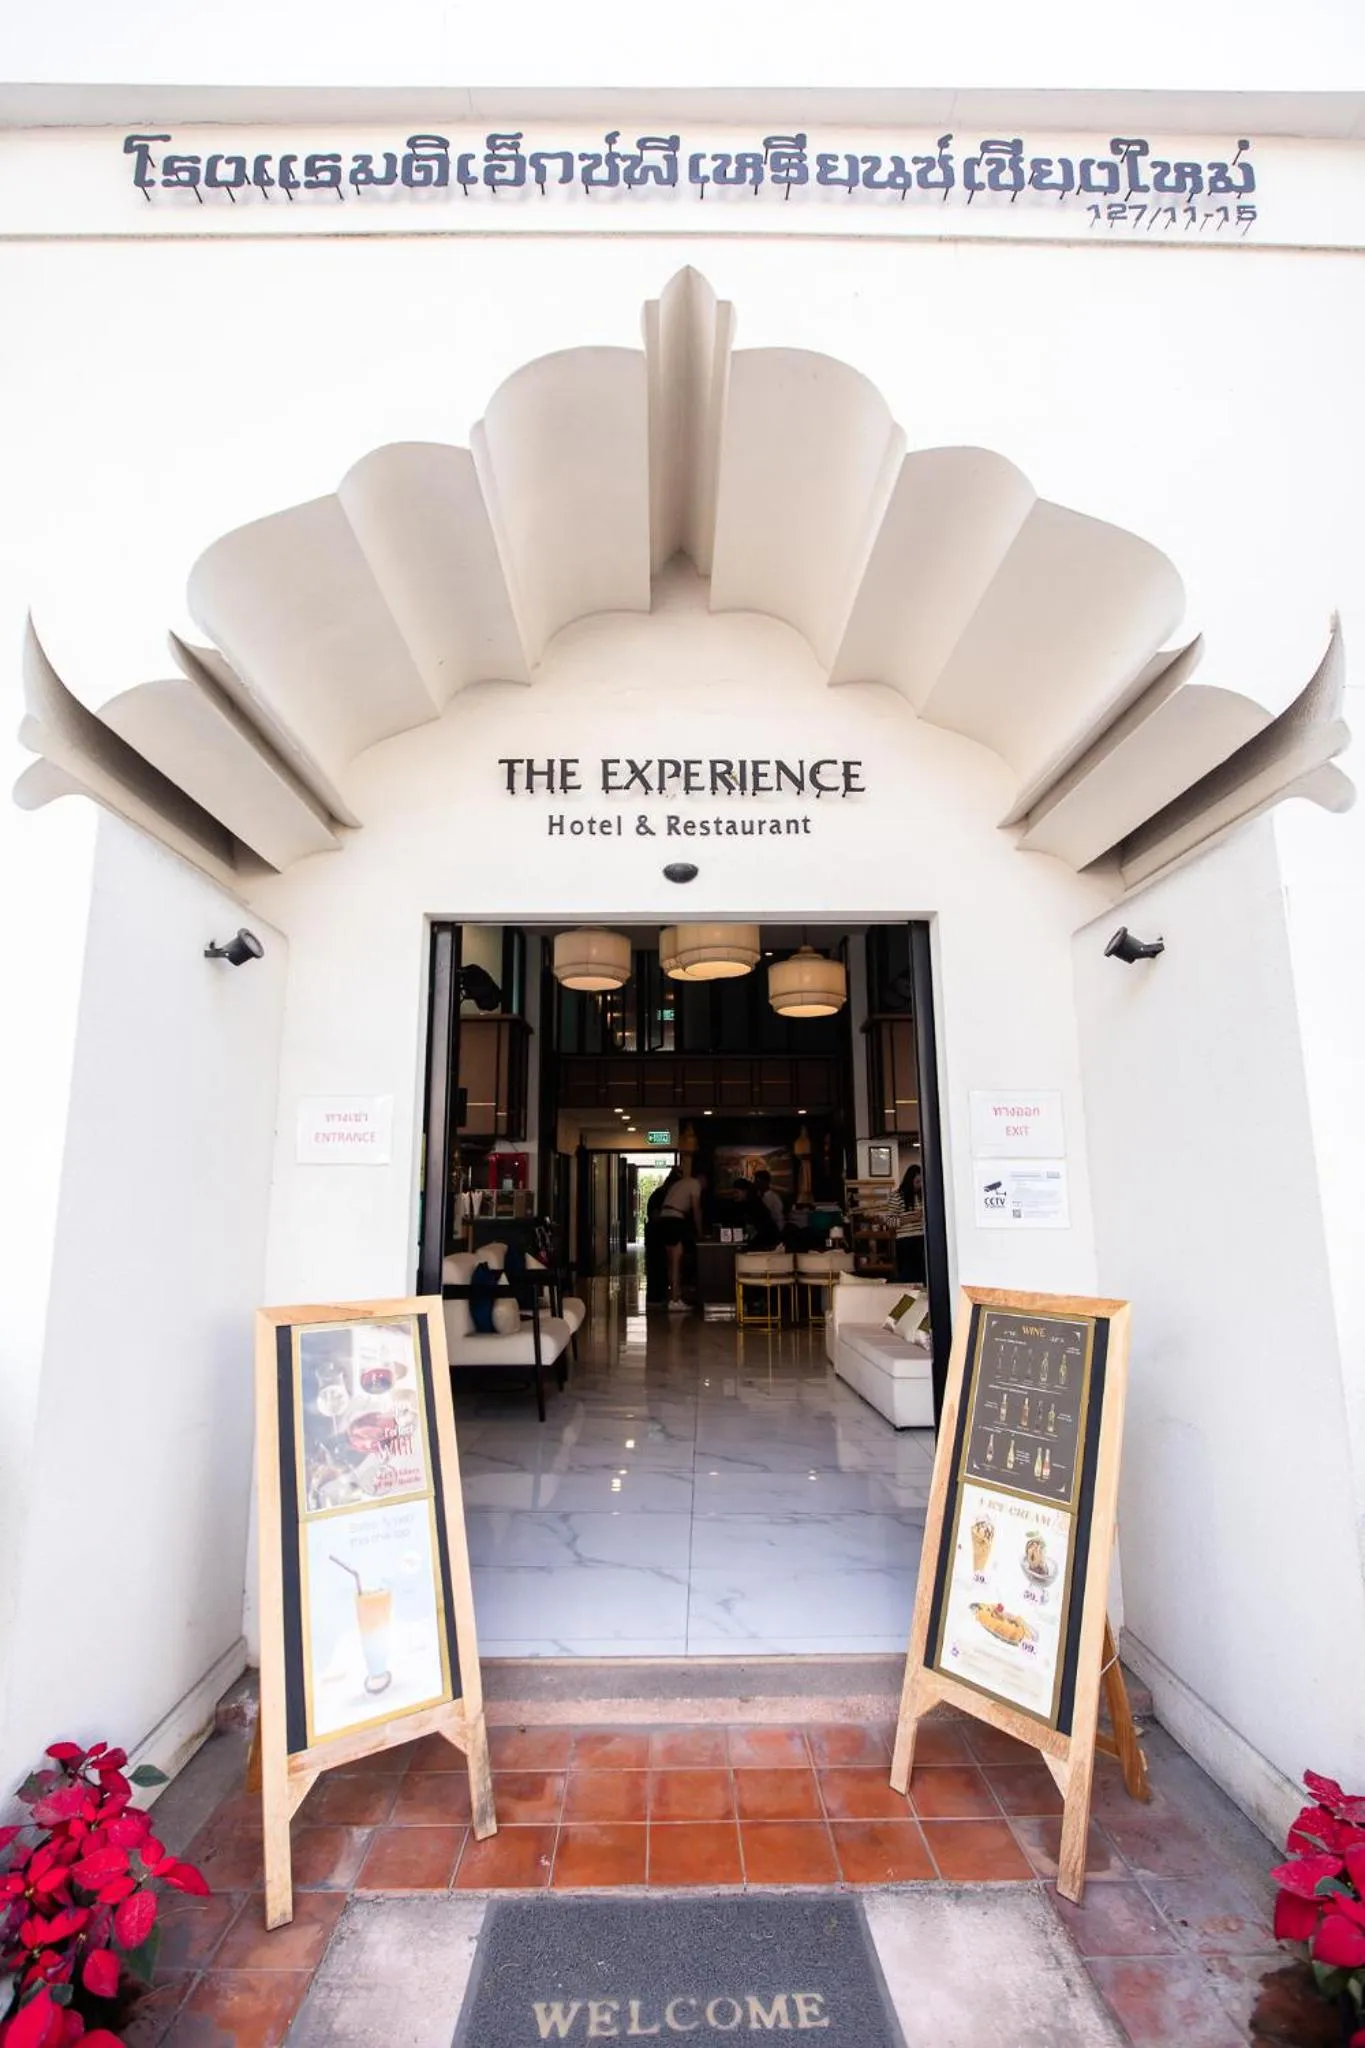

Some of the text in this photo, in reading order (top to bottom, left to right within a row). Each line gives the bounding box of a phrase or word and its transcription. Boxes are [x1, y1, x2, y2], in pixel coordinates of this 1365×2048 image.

[1086, 203, 1258, 224] 127/11-15
[498, 758, 866, 793] THE EXPERIENCE
[548, 814, 811, 836] Hotel & Restaurant
[314, 1130, 377, 1144] ENTRANCE
[1005, 1125, 1030, 1137] EXIT
[984, 1196, 1006, 1206] CCTV
[1022, 1324, 1047, 1338] WINE
[532, 1992, 830, 2039] WELCOME
